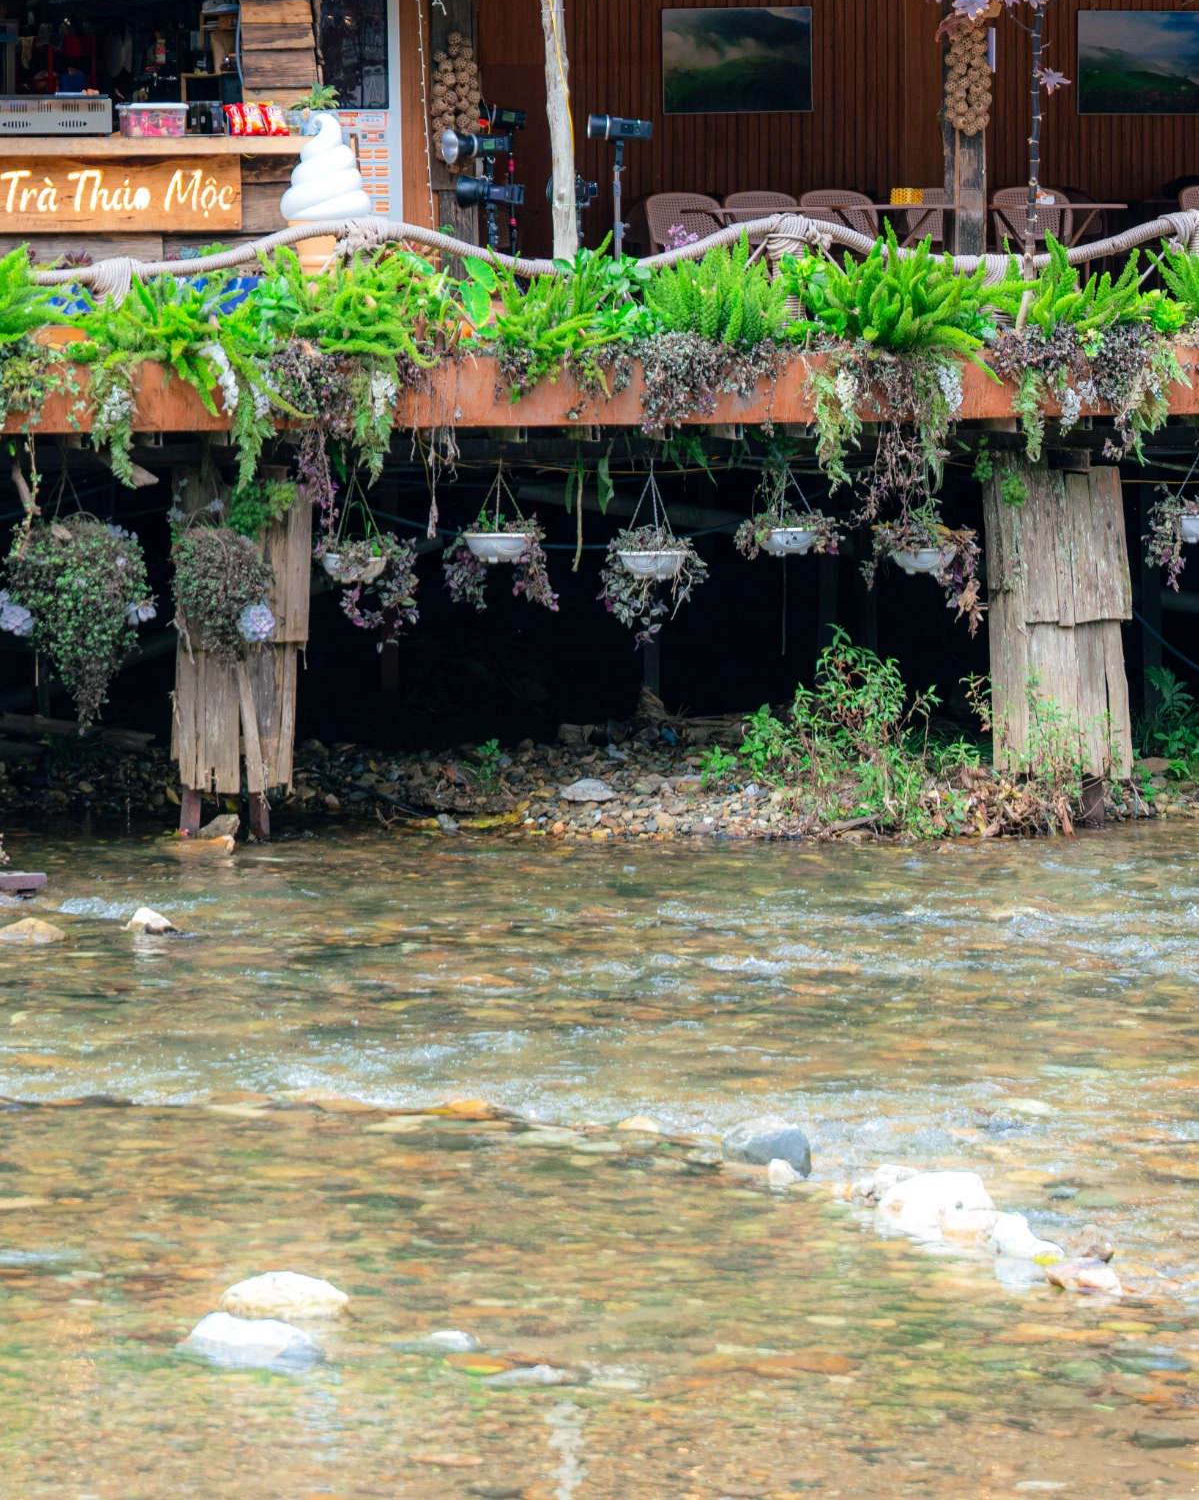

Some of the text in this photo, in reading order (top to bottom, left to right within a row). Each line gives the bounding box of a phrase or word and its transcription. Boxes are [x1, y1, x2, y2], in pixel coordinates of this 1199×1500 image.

[0, 168, 234, 218] Trà Thảo Mộc
